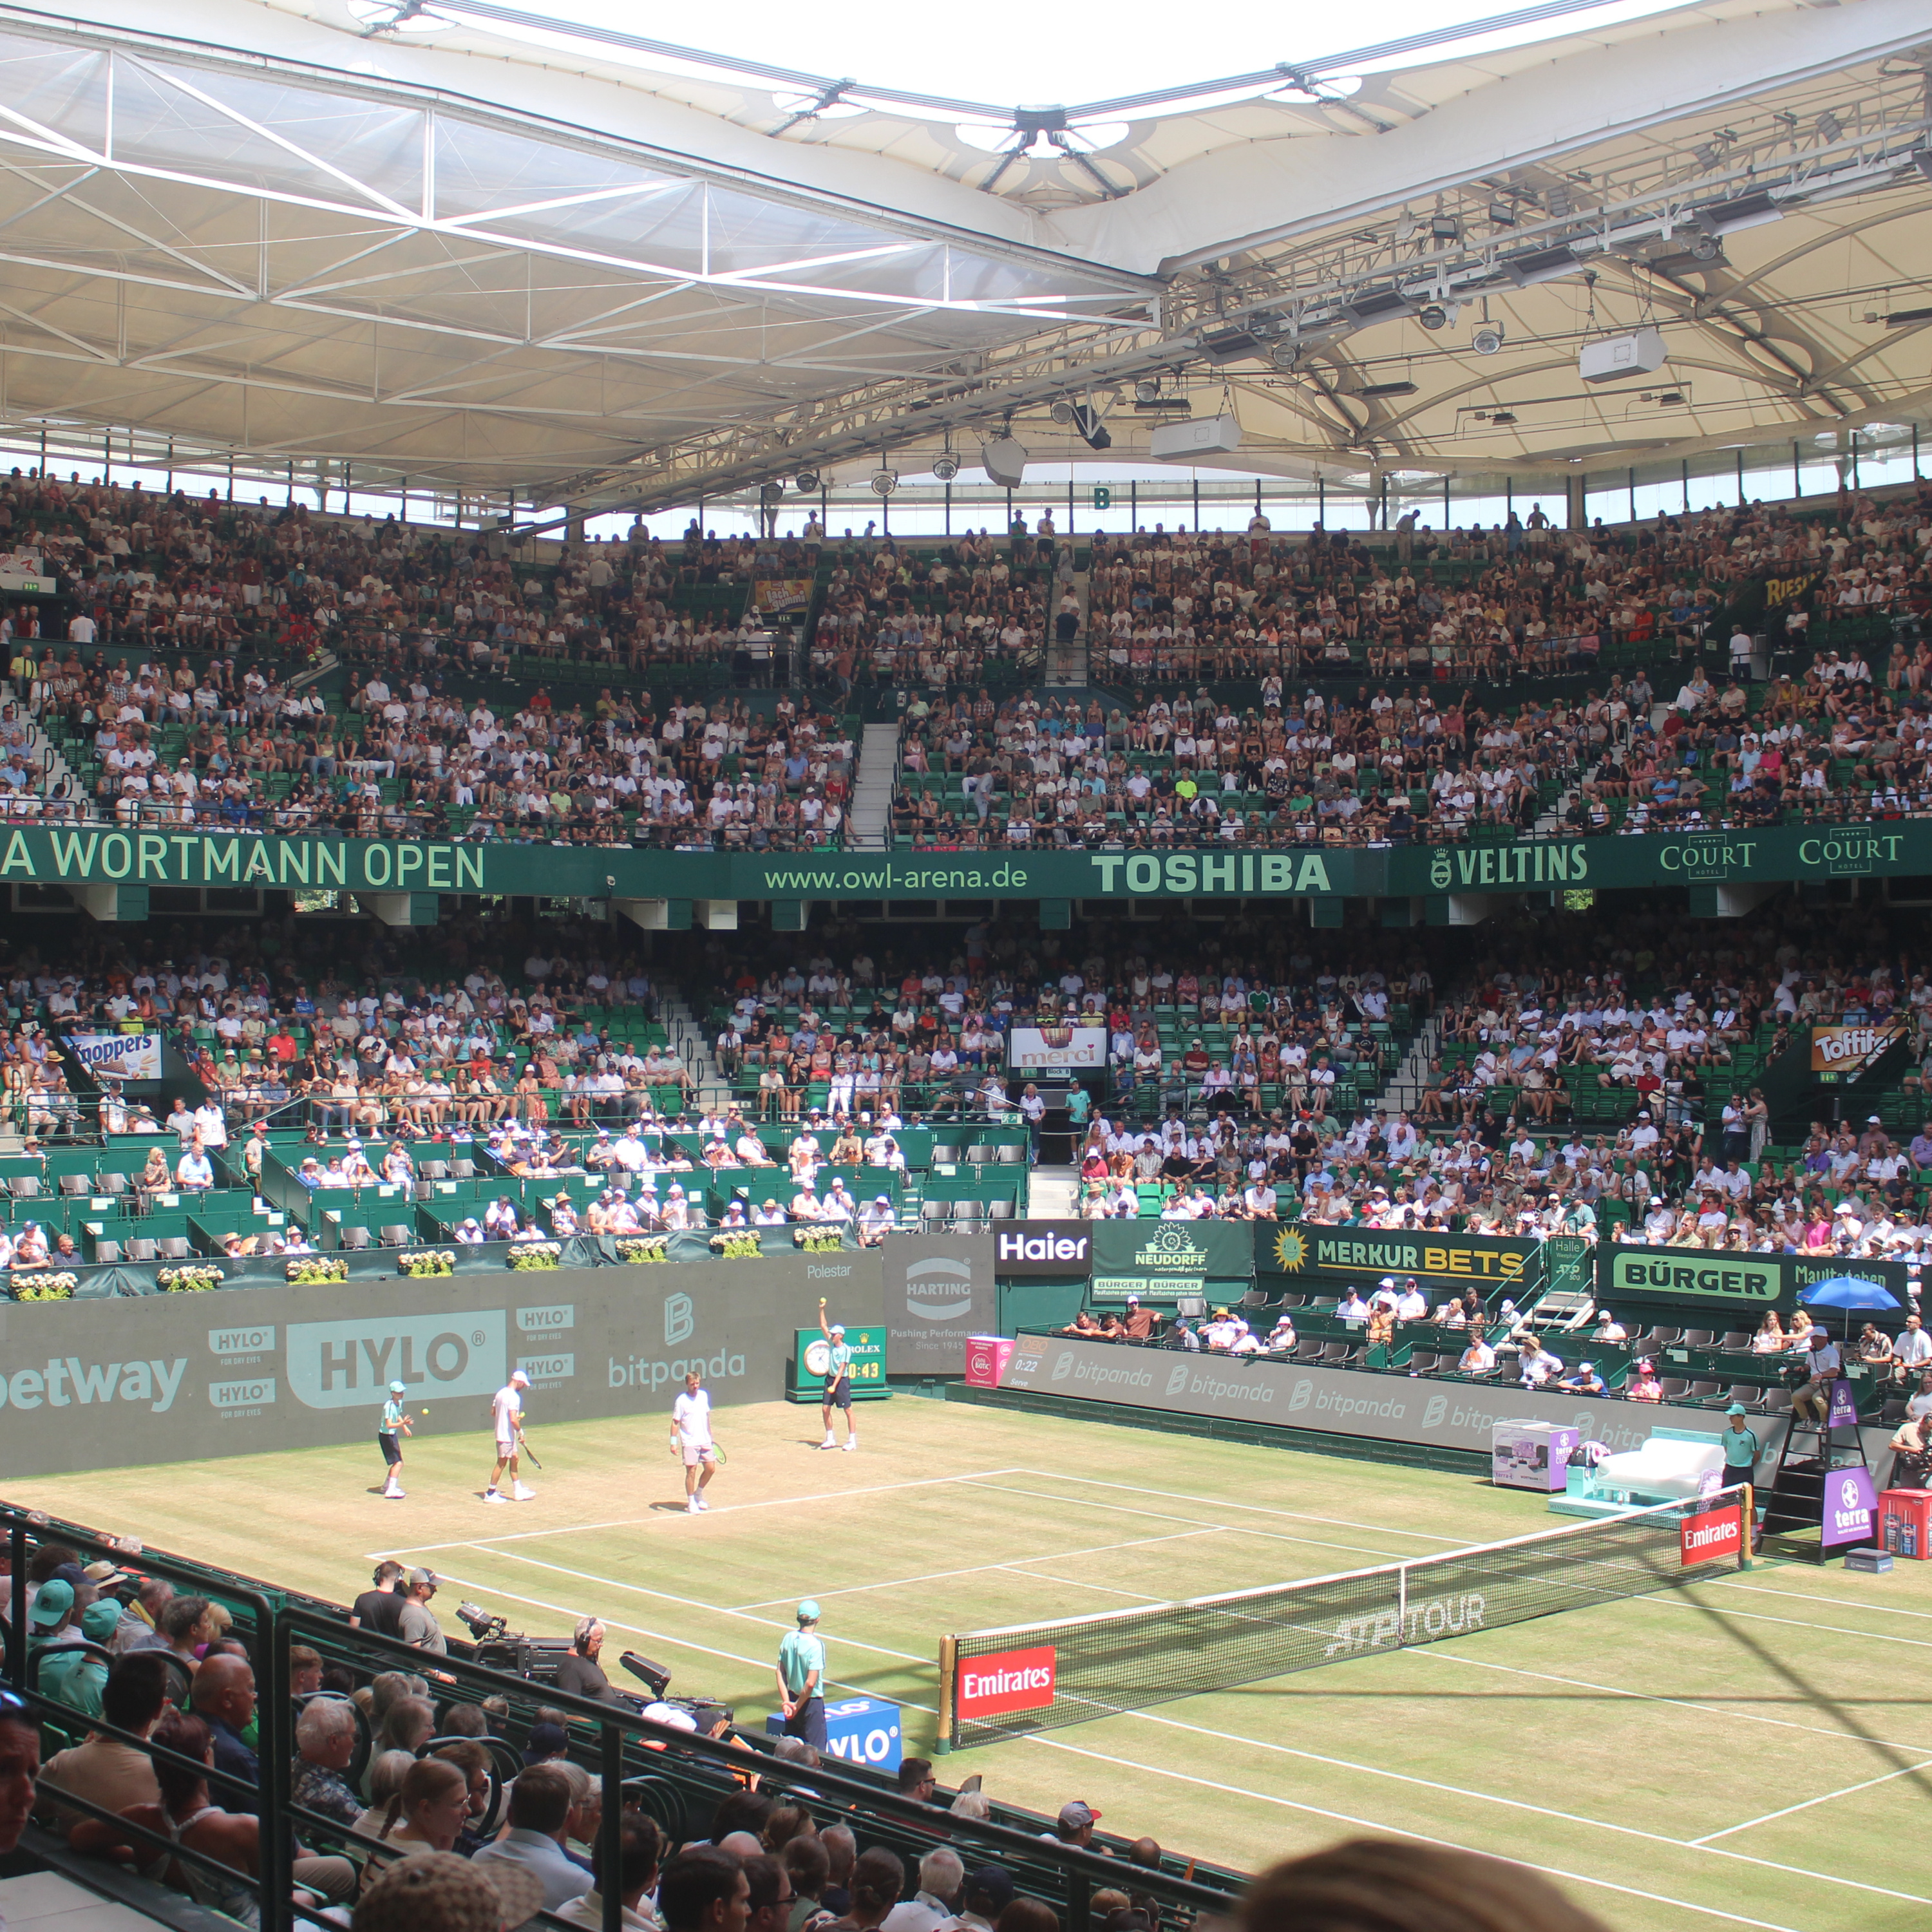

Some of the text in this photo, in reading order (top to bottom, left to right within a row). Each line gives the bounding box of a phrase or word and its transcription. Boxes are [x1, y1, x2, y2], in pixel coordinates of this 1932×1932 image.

[1094, 488, 1110, 510] B
[1, 829, 484, 889] A WORTMANN OPEN
[1660, 842, 1757, 870] COURT
[1799, 835, 1904, 864] COURT
[764, 861, 1028, 890] www.owl-arena.de
[1092, 854, 1332, 893] TOSHIBA
[1457, 844, 1588, 885] VELTINS
[1021, 1045, 1095, 1066] merci
[1814, 1028, 1897, 1063] Toffife
[1000, 1231, 1088, 1260] Haier
[1555, 1240, 1580, 1253] Halle
[1135, 1254, 1206, 1265] NEUDORFF
[1318, 1240, 1525, 1276] MERKUR BETS
[807, 1264, 852, 1280] Polestar
[1625, 1260, 1768, 1295] BÜRGER
[907, 1283, 971, 1295] HARTING
[1098, 1280, 1143, 1288] BÜRGER
[1153, 1280, 1198, 1289] BÜRGER
[891, 1329, 927, 1339] Pushing
[915, 1341, 963, 1350] Since 1945
[246, 1356, 261, 1364] EYES
[608, 1347, 746, 1392] bitpanda
[1015, 1359, 1038, 1372] 0:22
[0, 1357, 187, 1413] etway
[1010, 1378, 1029, 1387] Serve
[1074, 1361, 1153, 1388] bitpanda
[1190, 1374, 1274, 1403] bitpanda
[1315, 1388, 1406, 1419] bitpanda
[1833, 1405, 1852, 1416] terra
[1555, 1446, 1573, 1456] terra
[1555, 1455, 1569, 1465] CLOU
[1495, 1472, 1509, 1480] terra
[1549, 1503, 1576, 1513] WESTWING
[1834, 1508, 1870, 1529] terra
[1684, 1519, 1738, 1549] Emirates
[1325, 1593, 1486, 1656] ATP TOUR
[963, 1666, 1050, 1700] Emirates
